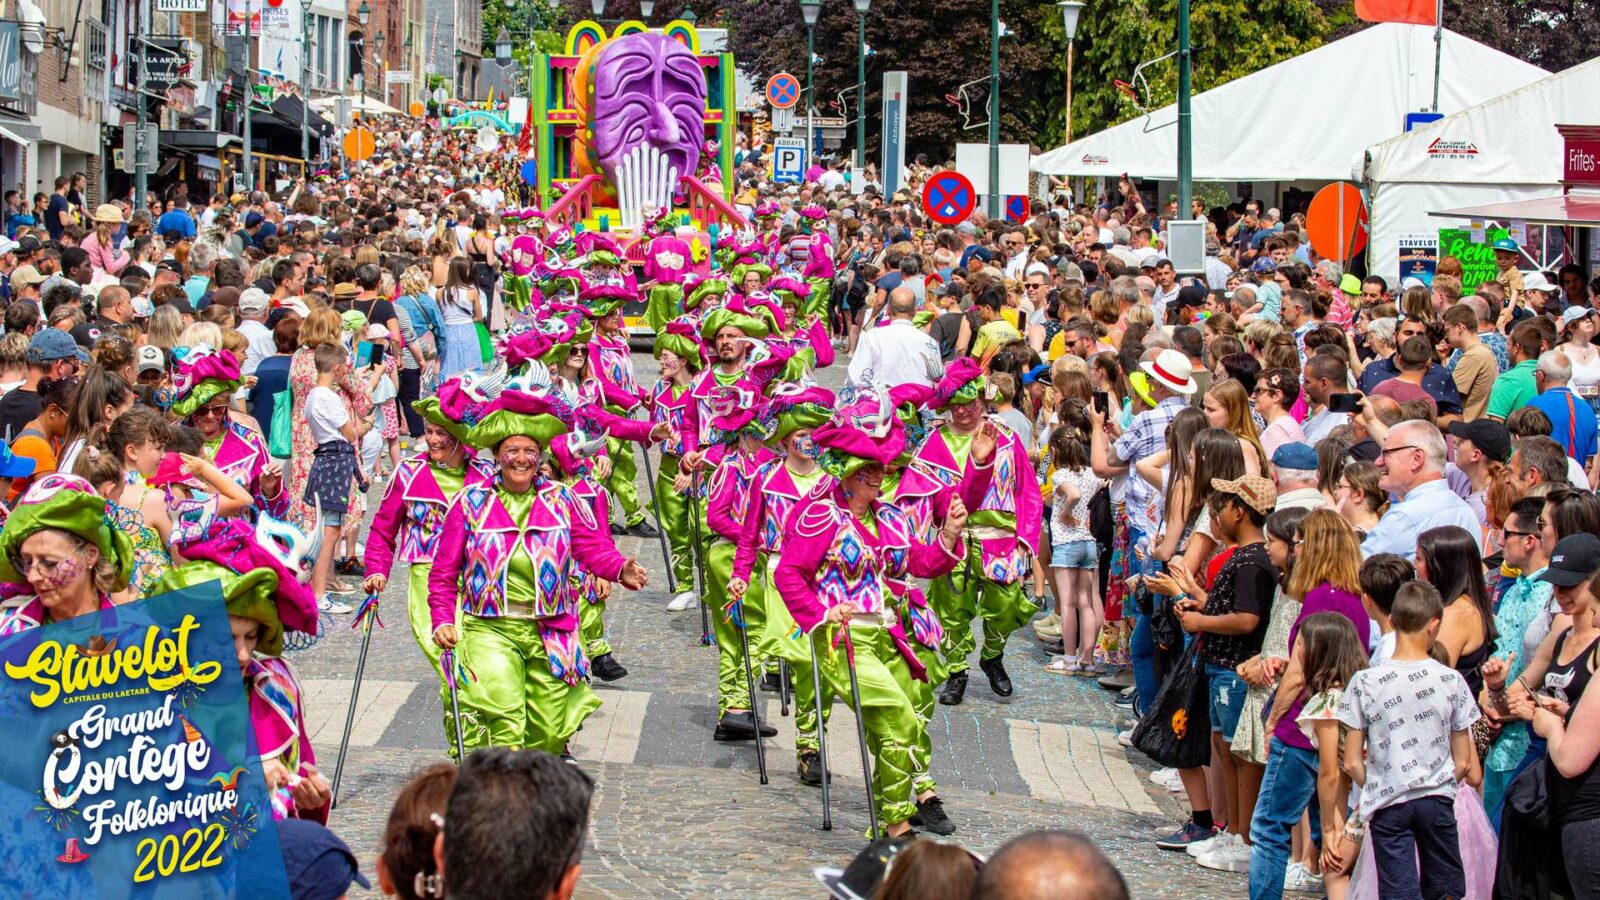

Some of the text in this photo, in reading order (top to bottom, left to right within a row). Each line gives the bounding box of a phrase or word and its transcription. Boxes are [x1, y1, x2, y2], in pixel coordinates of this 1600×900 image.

[262, 7, 289, 15] PRISES
[782, 151, 795, 169] P
[1569, 149, 1595, 172] Frites
[1378, 671, 1398, 685] PARIS
[1408, 669, 1429, 681] OSLO
[1415, 687, 1436, 700] BERLIN
[1383, 695, 1403, 709] OSLO
[1368, 713, 1382, 726] ARIS
[1414, 709, 1434, 722] PARIS
[1400, 737, 1419, 750] BERLIN
[1401, 759, 1418, 773] OSLO
